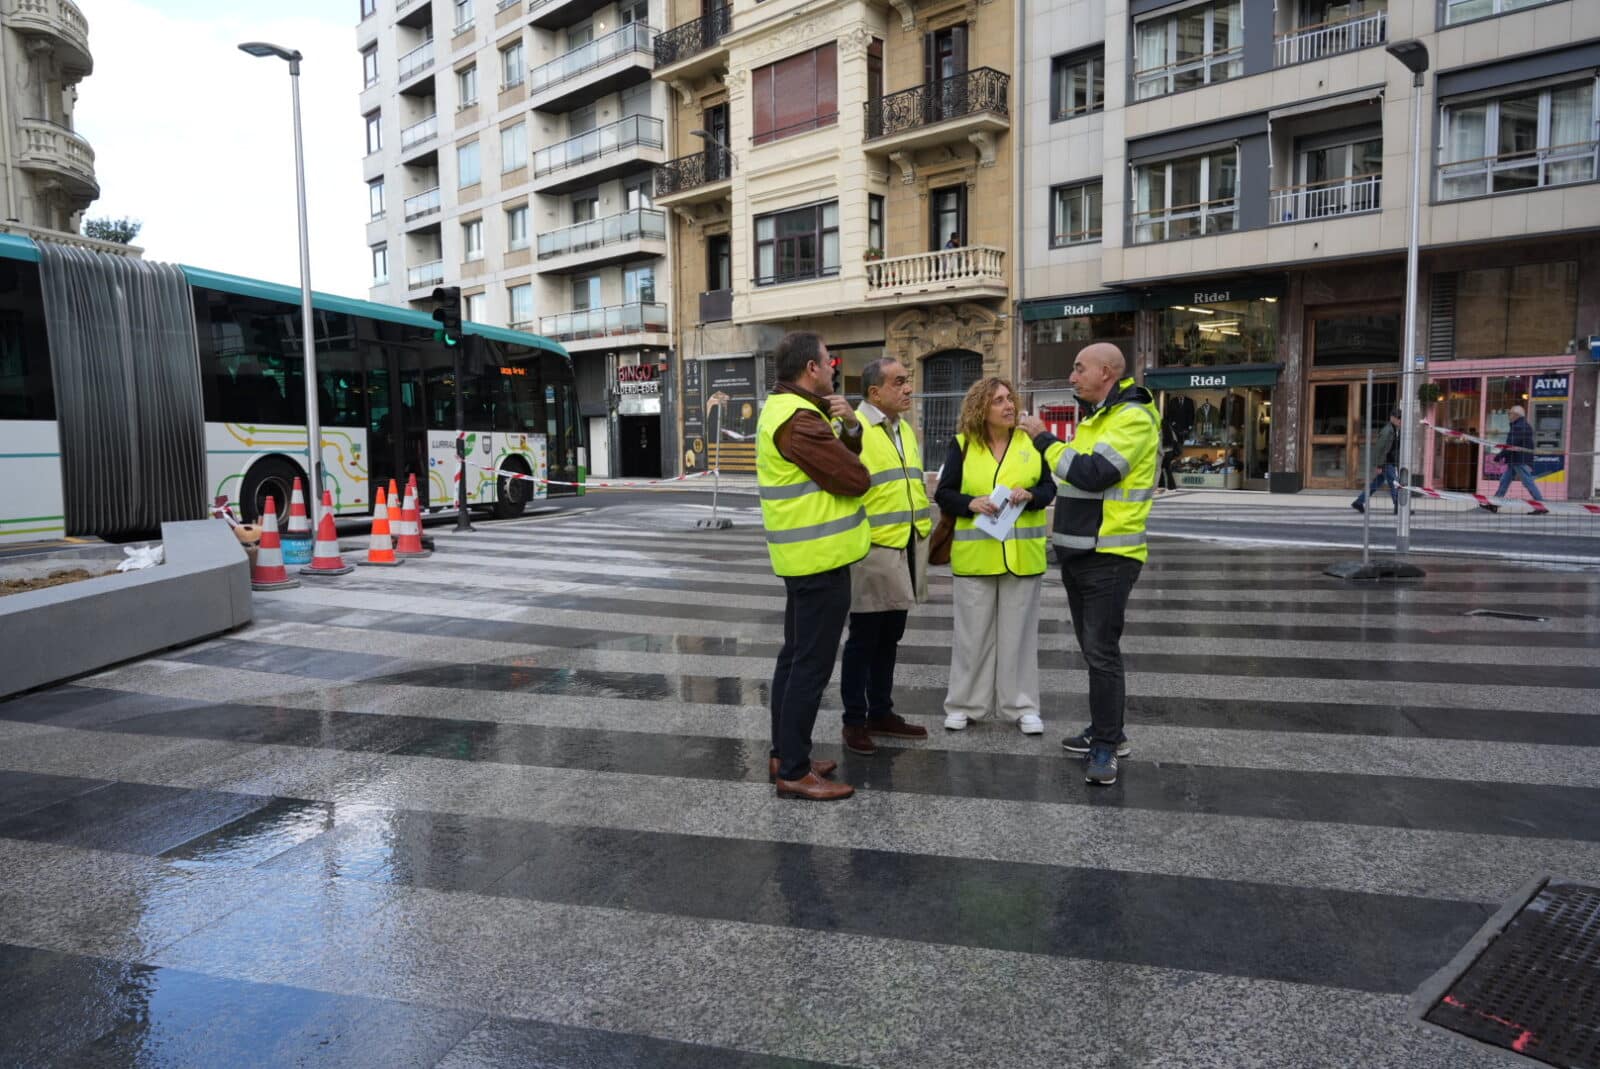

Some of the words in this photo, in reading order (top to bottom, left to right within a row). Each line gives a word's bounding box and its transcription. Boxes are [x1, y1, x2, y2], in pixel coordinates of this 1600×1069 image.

[1194, 291, 1230, 304] Ridel
[1064, 304, 1093, 316] Ridel
[617, 363, 653, 382] BINGO
[1190, 375, 1226, 387] Ridel
[1535, 378, 1567, 389] ATM
